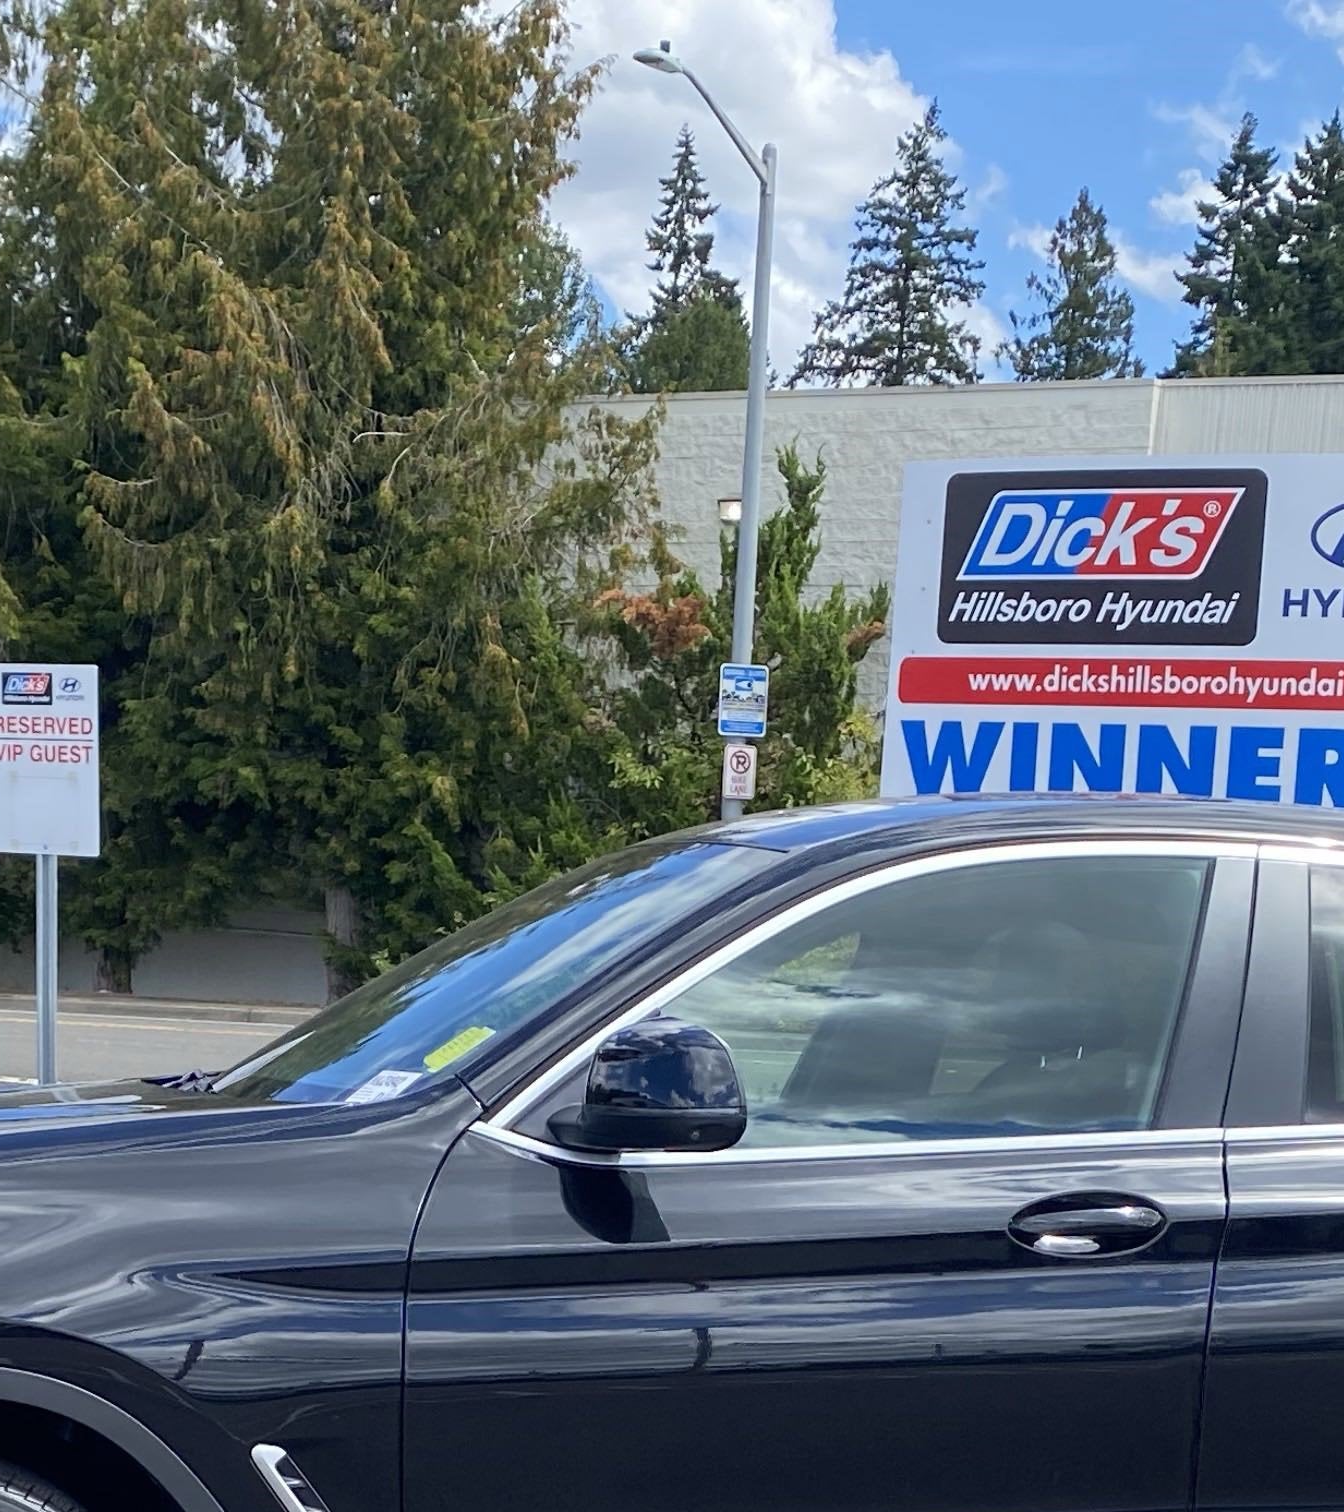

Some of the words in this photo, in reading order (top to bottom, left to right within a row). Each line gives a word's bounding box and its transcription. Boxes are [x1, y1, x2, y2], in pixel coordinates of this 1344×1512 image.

[948, 592, 1090, 624] Hillsboro
[1096, 592, 1241, 632] Hyundai
[30, 744, 94, 764] GUEST
